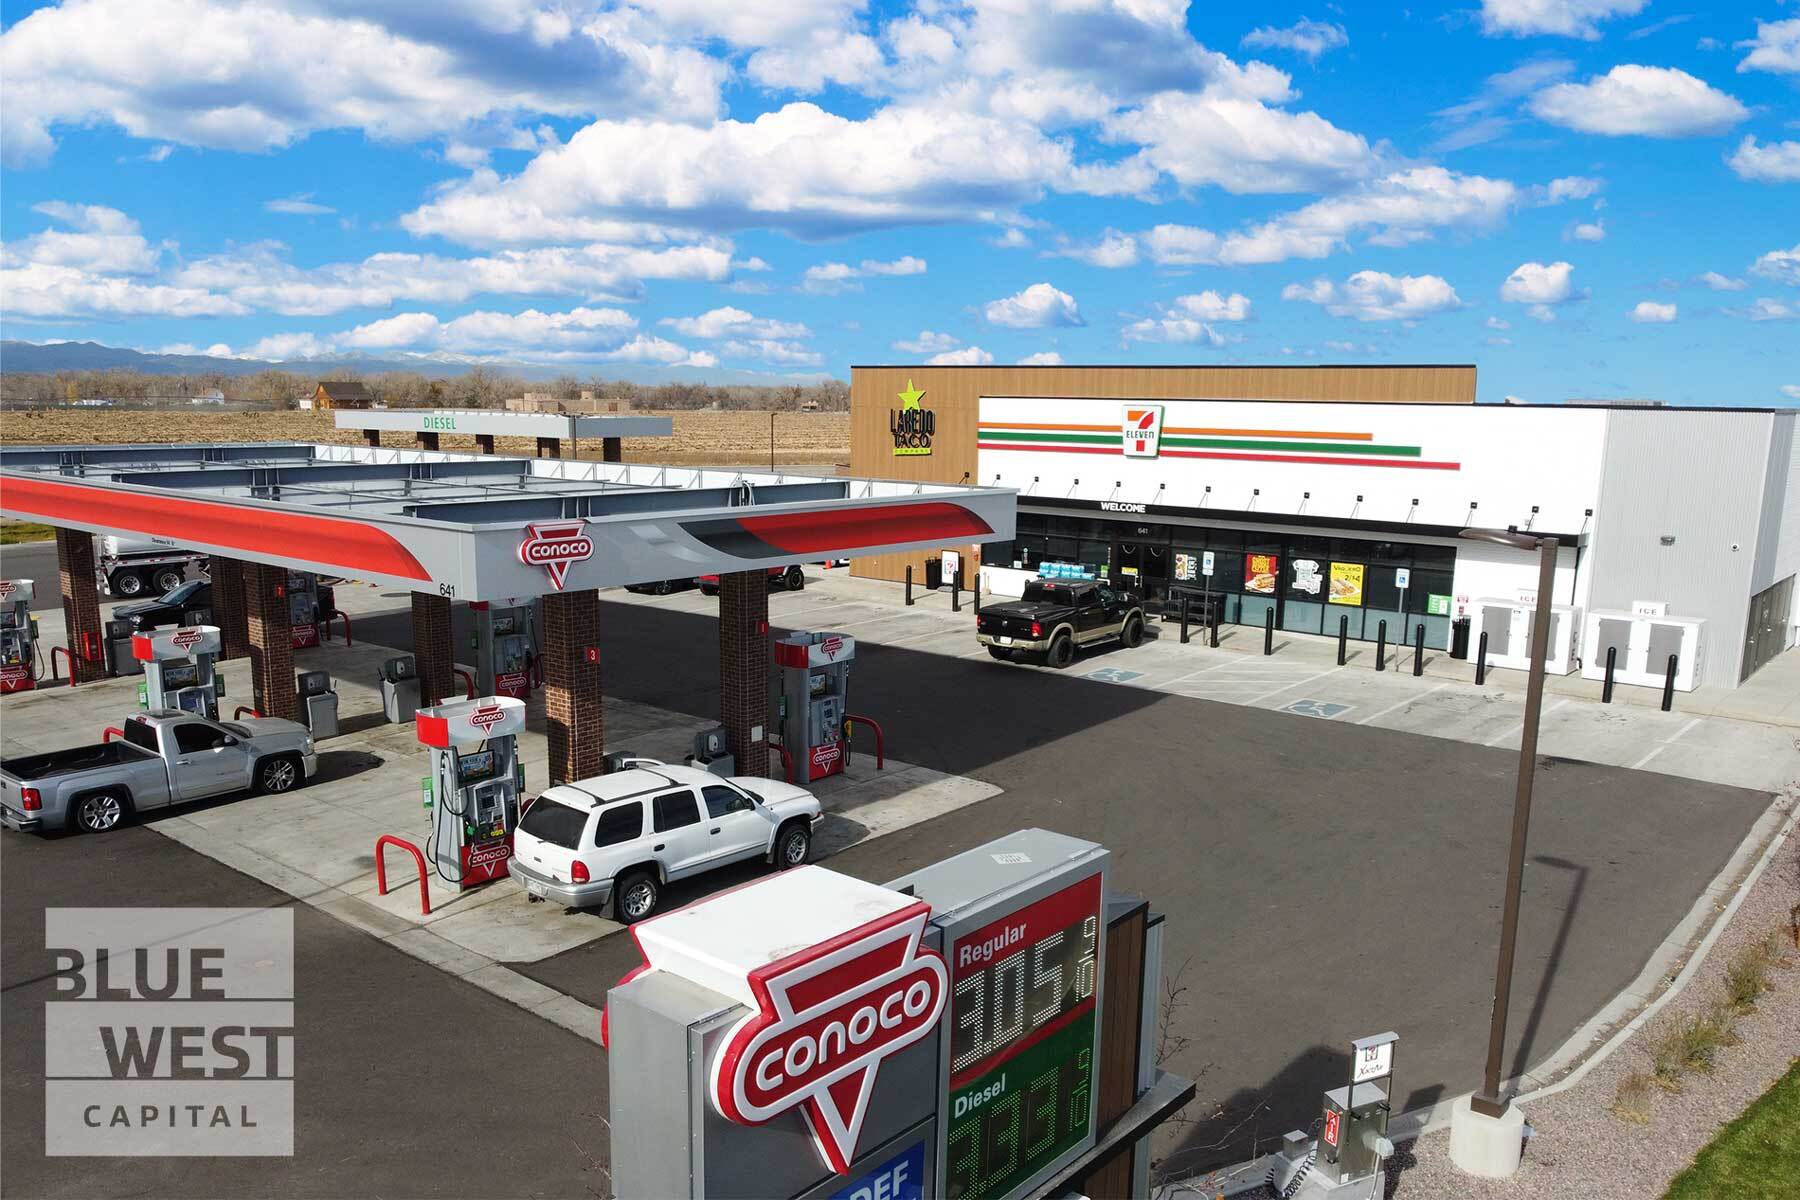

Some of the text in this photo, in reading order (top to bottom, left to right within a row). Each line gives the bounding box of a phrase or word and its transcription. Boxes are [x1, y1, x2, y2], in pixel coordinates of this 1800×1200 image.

[424, 416, 457, 430] DIESEL
[890, 408, 935, 436] LAREDO
[1127, 410, 1155, 452] 7
[893, 432, 931, 448] TACO
[1101, 501, 1146, 514] WELCOME
[439, 583, 455, 598] 641
[590, 650, 596, 661] 3
[959, 923, 1027, 968] Regular
[955, 1073, 1006, 1119] Diesel
[1326, 1114, 1337, 1141] AIR
